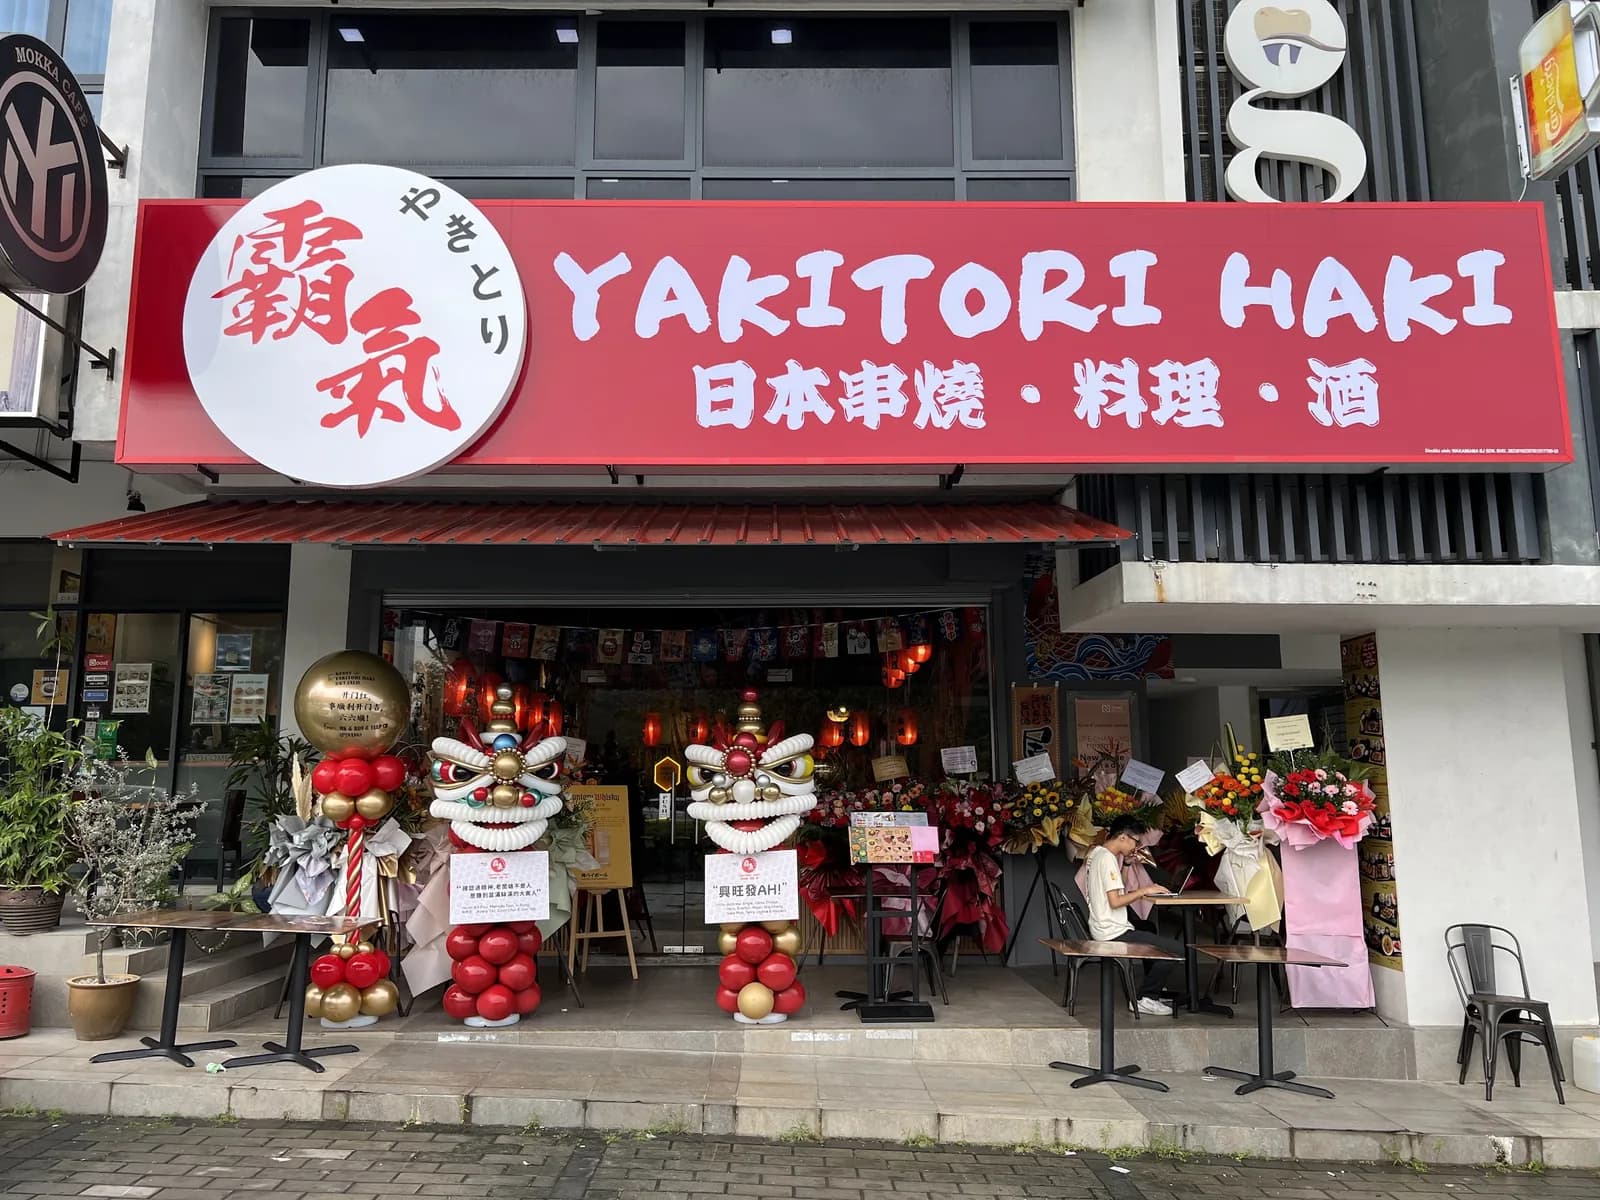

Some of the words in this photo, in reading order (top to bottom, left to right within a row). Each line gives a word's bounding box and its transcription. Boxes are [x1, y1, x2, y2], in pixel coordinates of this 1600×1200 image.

[15, 46, 60, 82] MOKKA
[62, 79, 89, 128] CAFE
[399, 184, 510, 355] やきとり
[553, 249, 1162, 344] YAKITORI
[1219, 249, 1513, 342] HAKI
